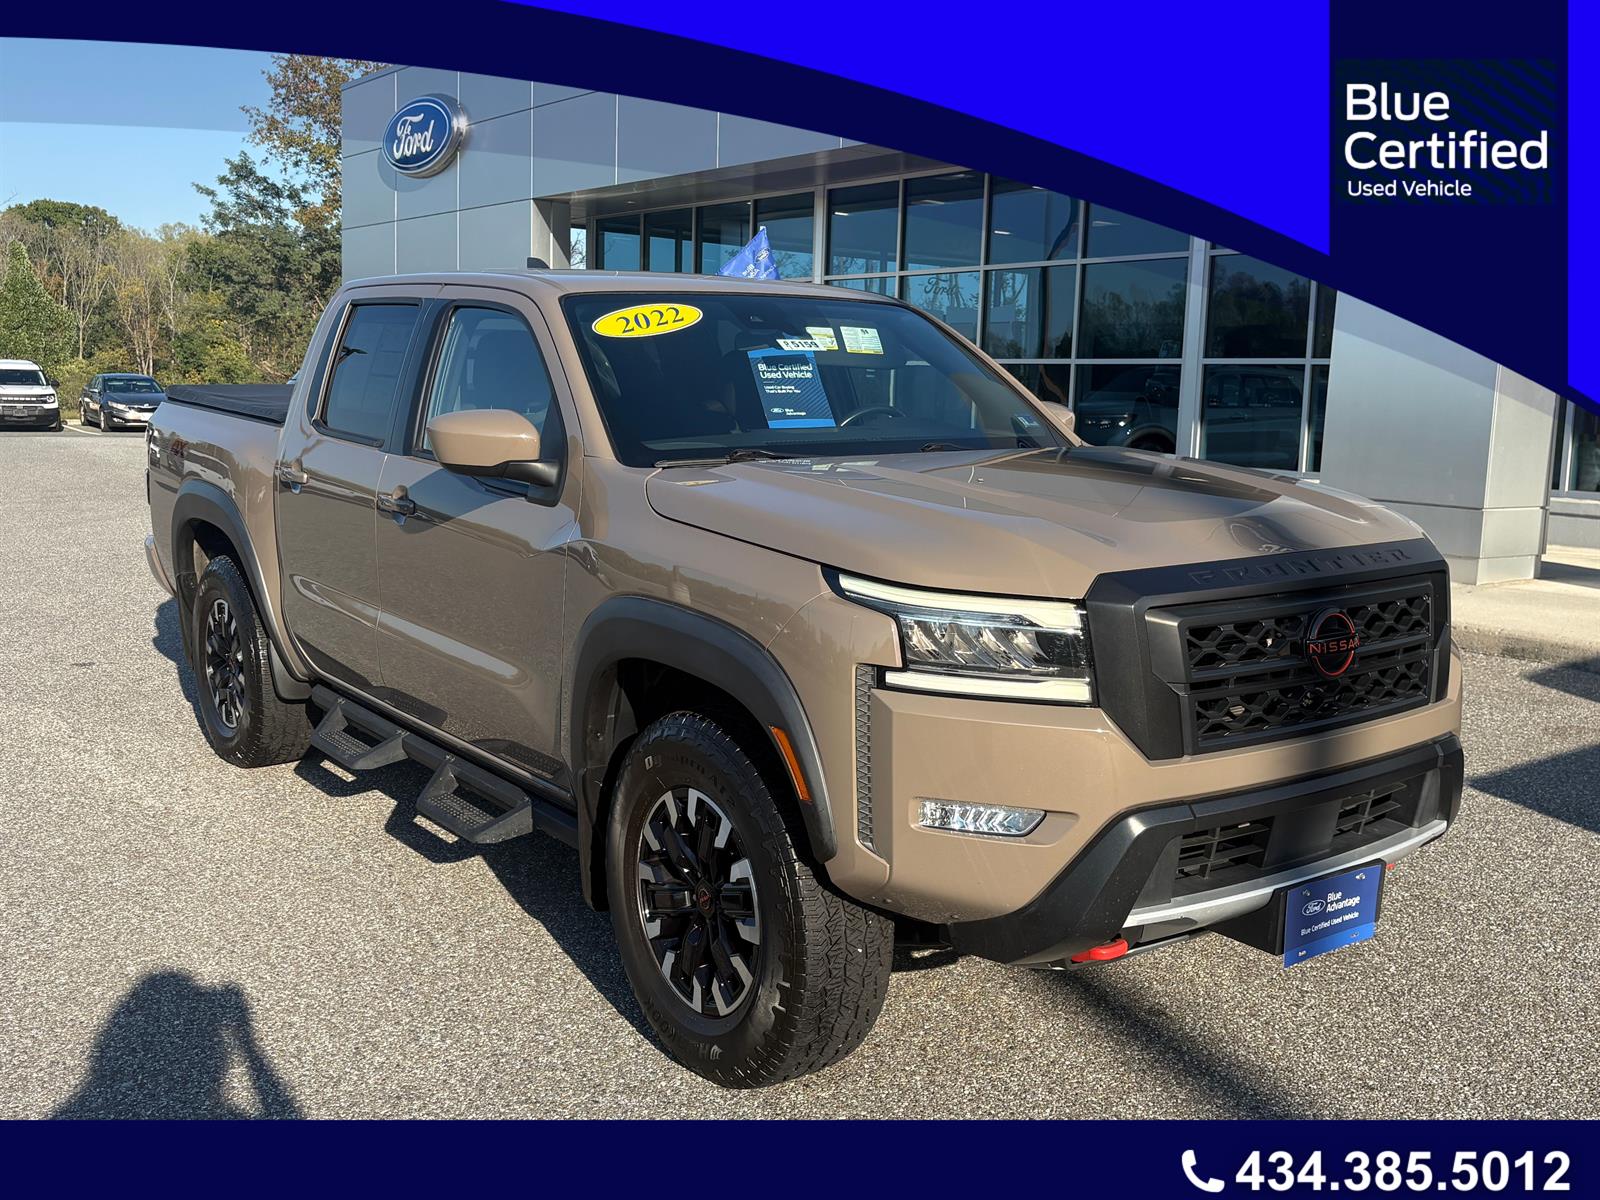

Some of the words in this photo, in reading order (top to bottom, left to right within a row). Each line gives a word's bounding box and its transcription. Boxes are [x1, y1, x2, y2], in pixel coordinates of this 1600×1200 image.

[393, 112, 434, 160] Ford
[615, 306, 684, 334] 2022
[791, 340, 819, 349] 5159
[760, 371, 782, 379] Used
[782, 371, 813, 379] Vehicle
[1187, 548, 1413, 586] FRONTIER
[1308, 632, 1361, 655] NISSAN
[1306, 902, 1321, 913] Ford
[1326, 896, 1360, 913] Advantage
[1327, 892, 1342, 902] Blue
[1301, 928, 1311, 936] Blue
[1311, 921, 1330, 932] Certified
[1331, 917, 1342, 925] Used
[1343, 911, 1359, 921] Vehicle
